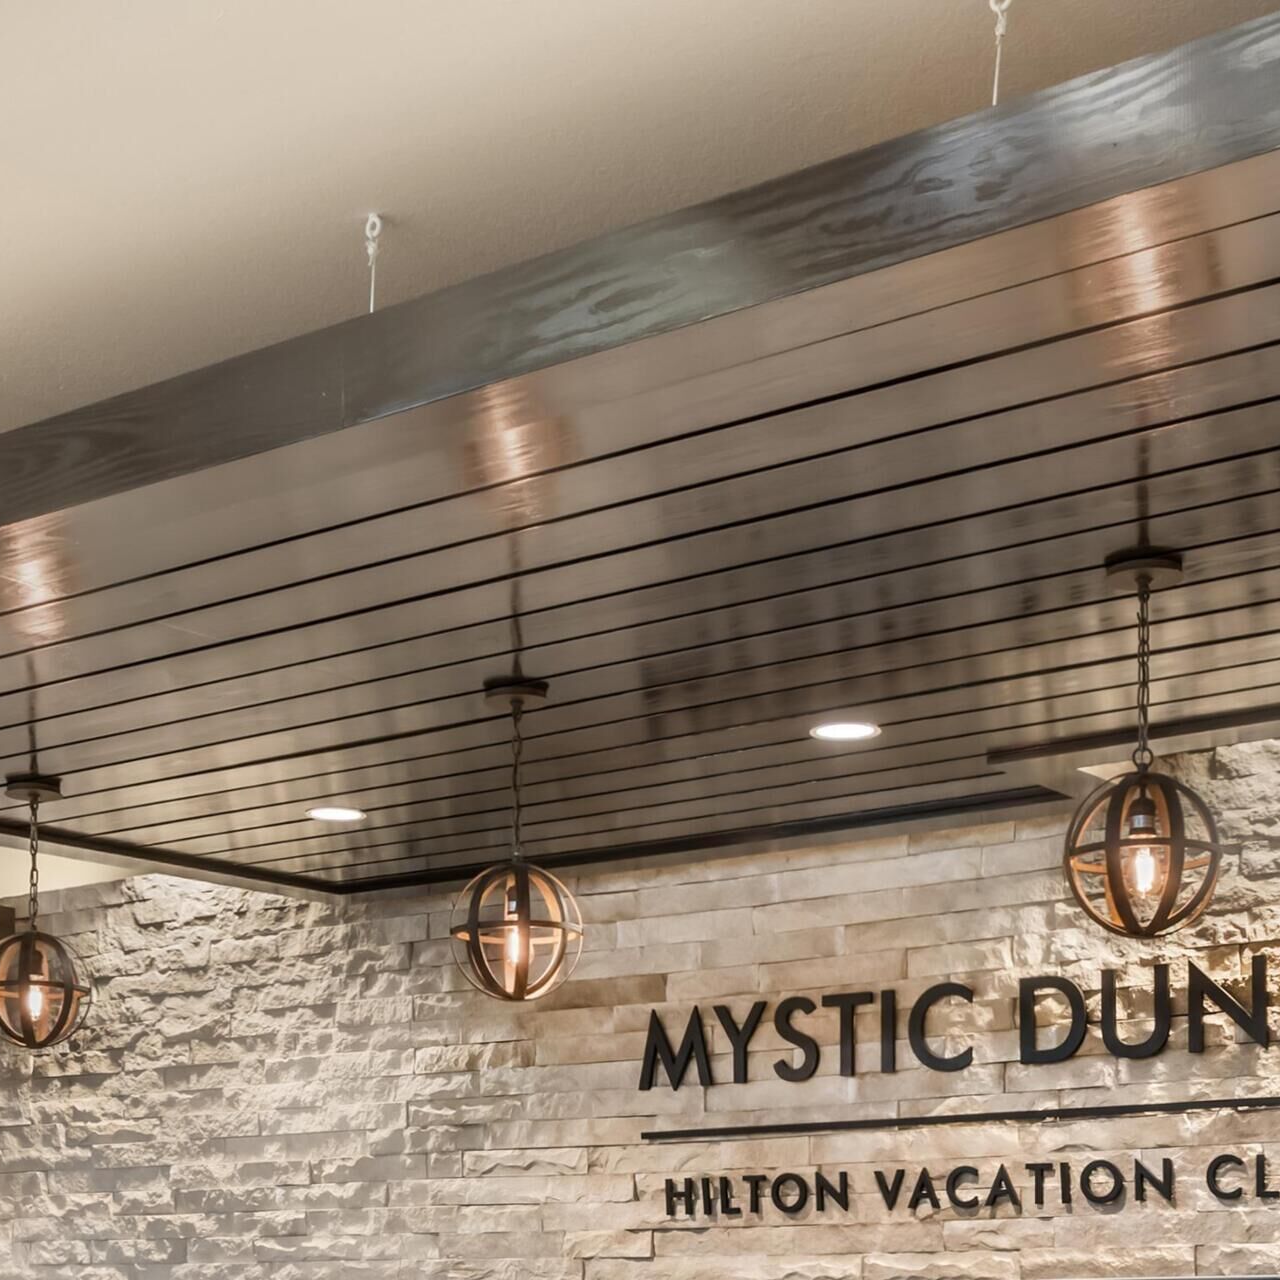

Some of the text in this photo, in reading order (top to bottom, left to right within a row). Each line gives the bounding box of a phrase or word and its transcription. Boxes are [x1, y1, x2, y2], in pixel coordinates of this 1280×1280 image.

[638, 981, 974, 1092] MYSTIC
[664, 1170, 850, 1219] HILTON
[874, 1157, 1175, 1212] VACATION
